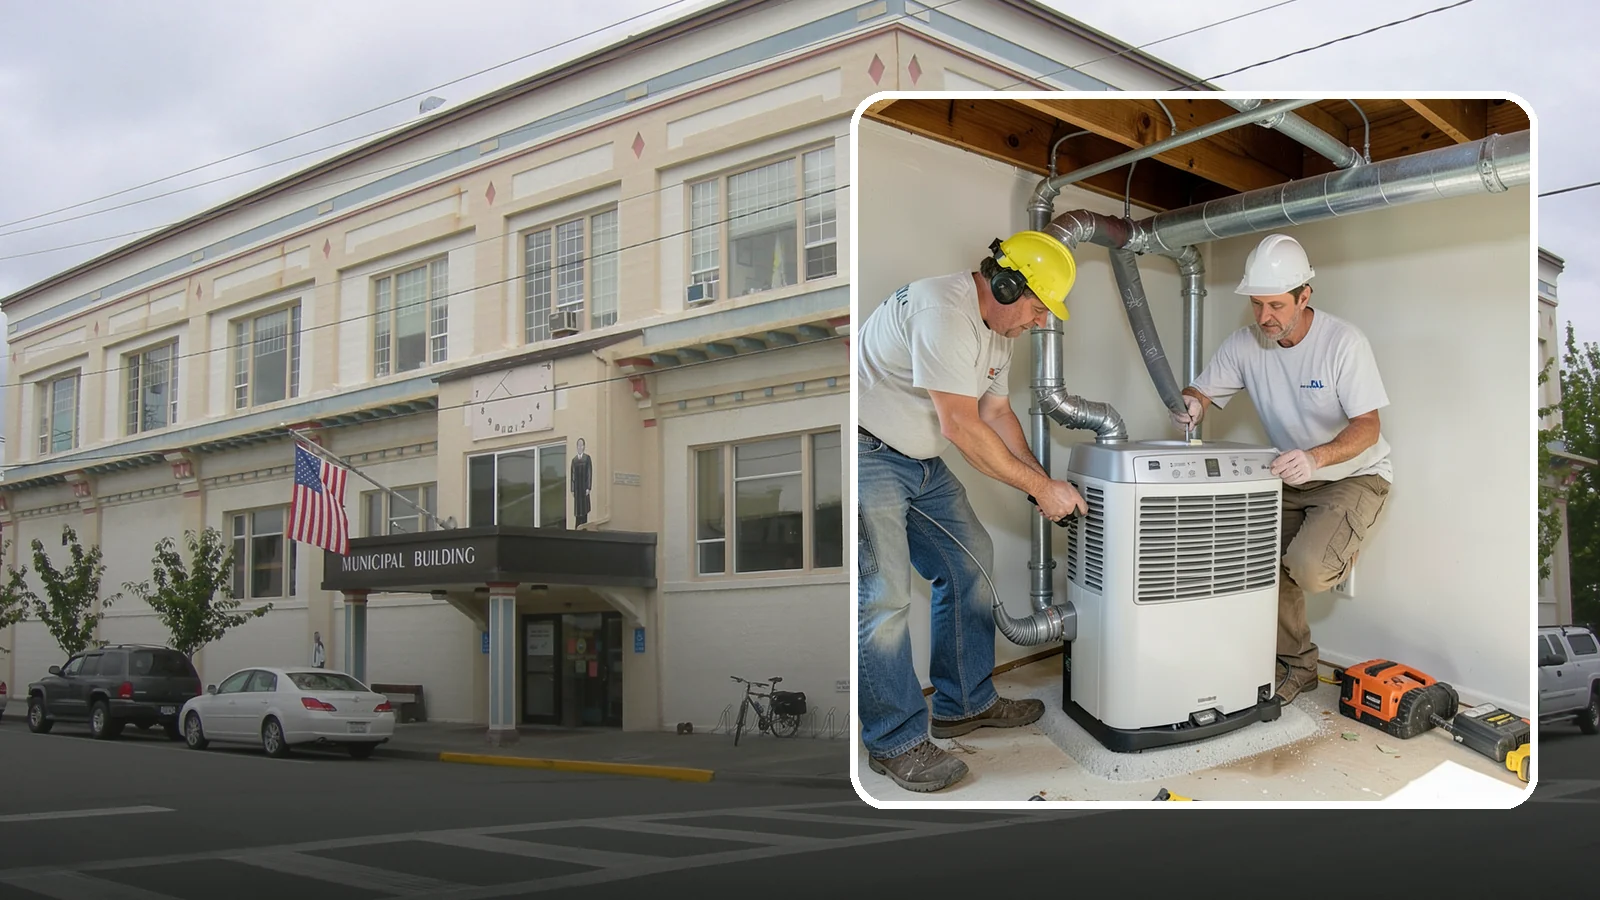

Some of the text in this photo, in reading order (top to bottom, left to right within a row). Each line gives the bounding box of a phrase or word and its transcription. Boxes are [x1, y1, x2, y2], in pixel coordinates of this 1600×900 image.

[480, 407, 485, 415] 8
[487, 417, 492, 425] 9
[521, 420, 526, 428] 2
[507, 425, 513, 433] 12
[342, 546, 475, 572] MUNICIPAL BUILDING
